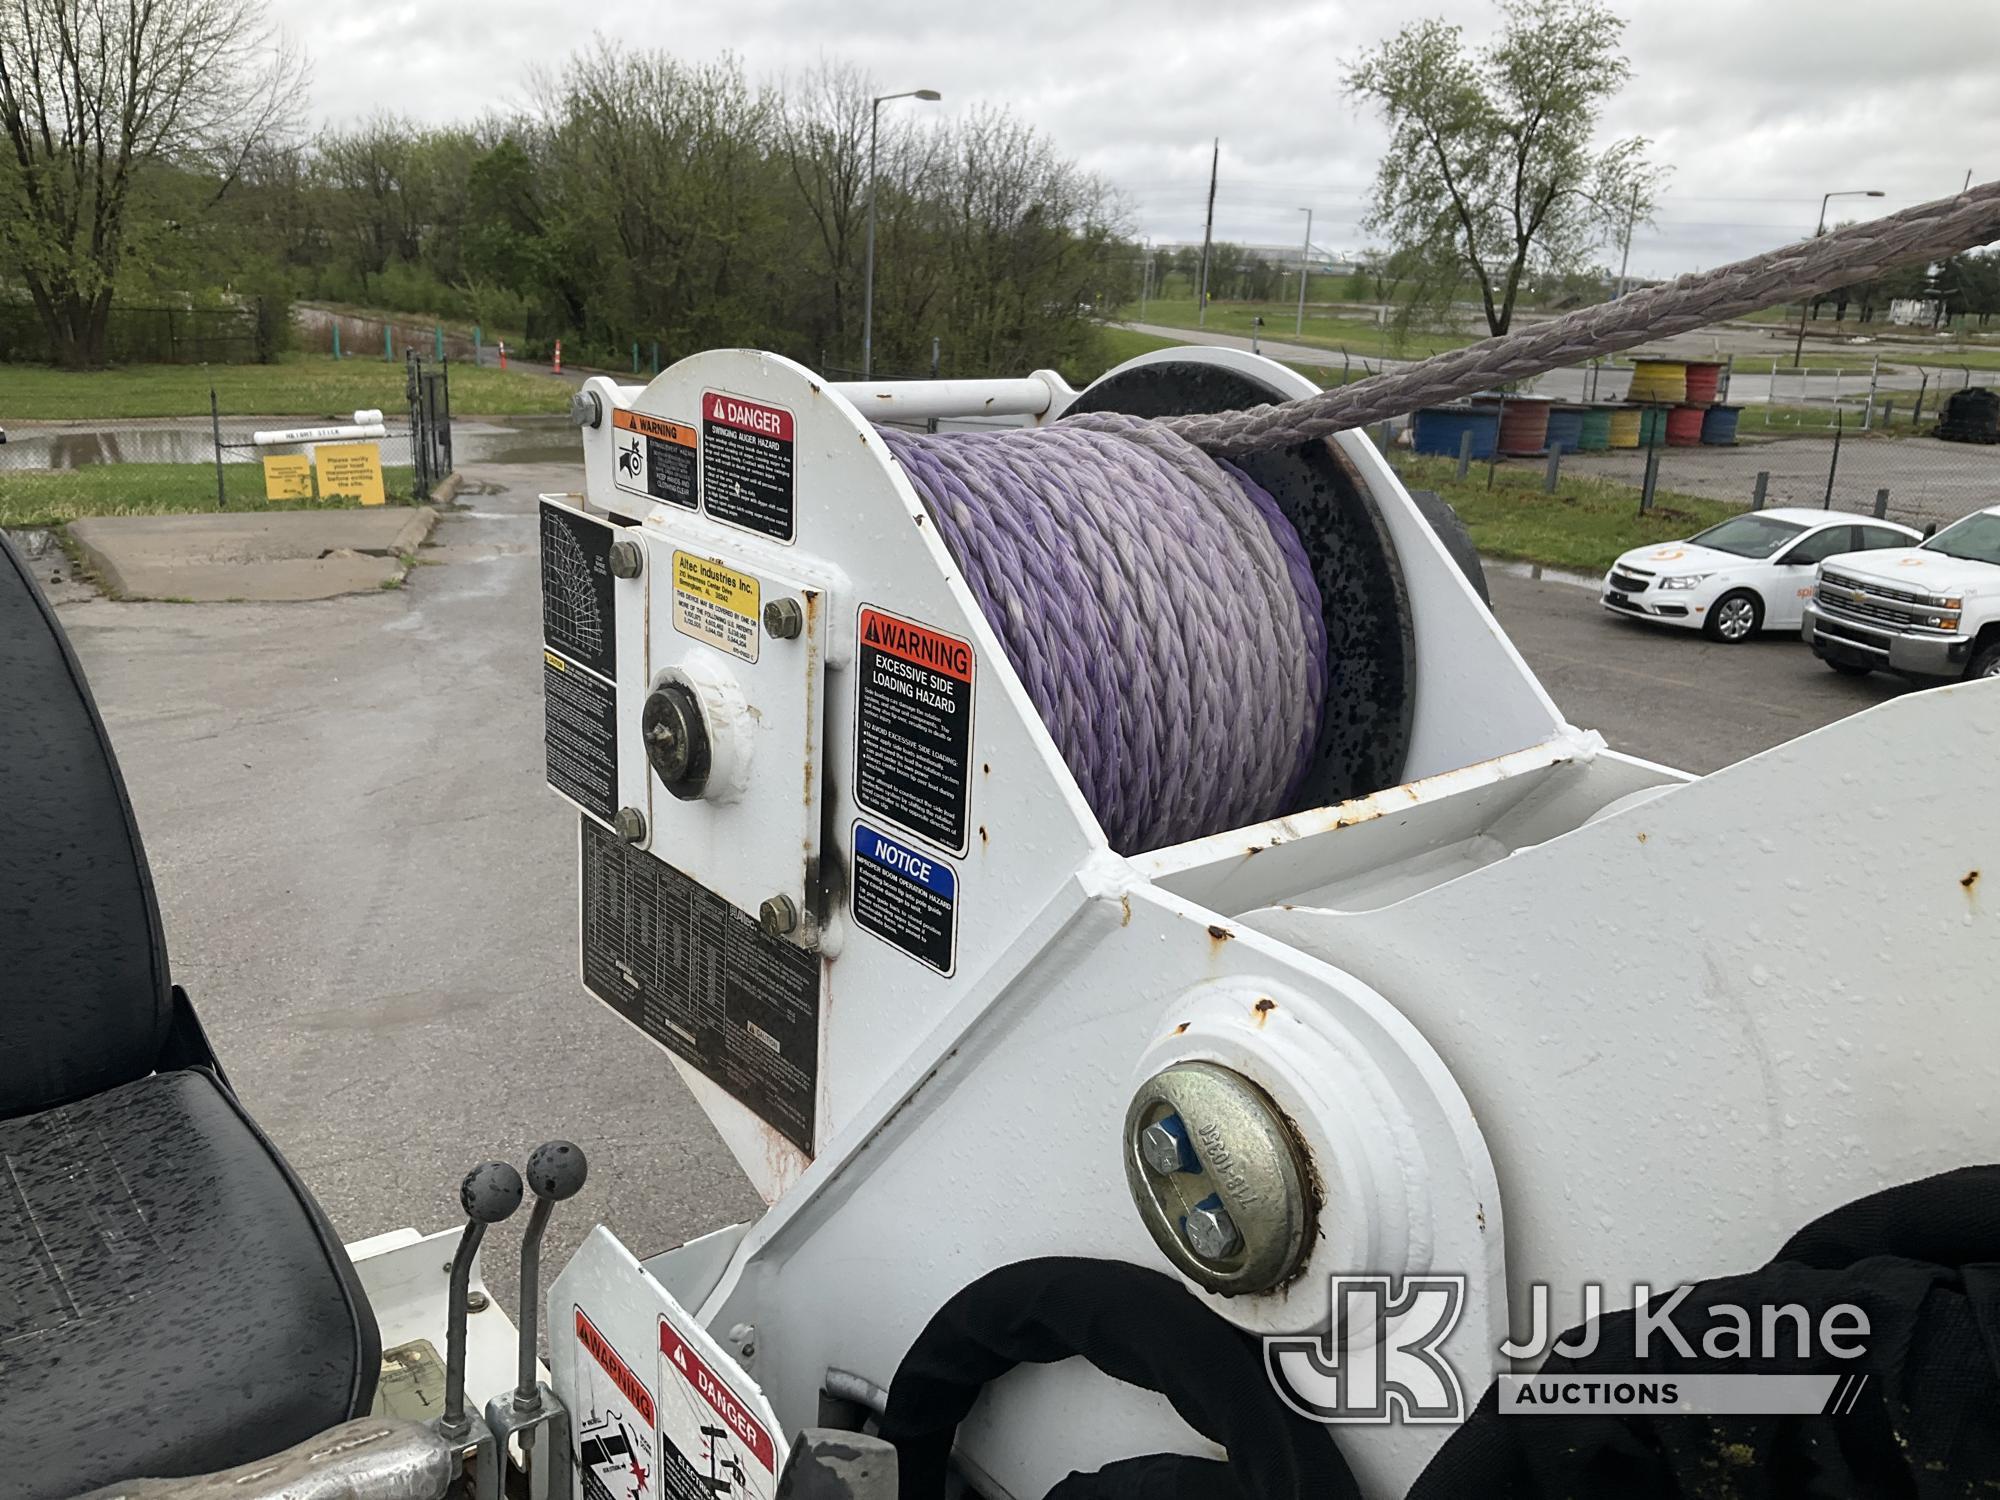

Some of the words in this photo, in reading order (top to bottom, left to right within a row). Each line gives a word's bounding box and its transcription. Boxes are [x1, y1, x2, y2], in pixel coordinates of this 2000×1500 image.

[640, 418, 677, 439] WARNING
[712, 425, 737, 439] SWINGING
[739, 433, 756, 445] AUGER
[758, 438, 779, 451] HAZARD
[728, 403, 781, 434] DANGER
[680, 557, 697, 573] Altec
[701, 565, 736, 588] Industries
[740, 579, 753, 594] Inc.
[1796, 586, 1814, 600] spi
[881, 621, 968, 676] WARNING
[873, 671, 913, 698] LOADING
[916, 687, 955, 715] HAZARD
[876, 654, 928, 686] EXCESSIVE
[930, 675, 954, 696] SIDE
[864, 720, 871, 729] TO
[872, 724, 887, 736] AVOID
[888, 731, 917, 749] EXCESSIVE
[918, 744, 930, 755] SIDE
[932, 750, 958, 767] LOADING:
[857, 855, 881, 873] IMPROPER
[882, 869, 897, 882] BOOM
[899, 878, 927, 898] OPERATION
[929, 894, 951, 911] HAZARD
[875, 838, 932, 885] NOTICE
[757, 1028, 778, 1048] CAUTION
[1198, 1122, 1258, 1210] 718-10350
[589, 1336, 651, 1419] WARNING
[698, 1369, 757, 1447] DANGER
[677, 1454, 714, 1499] ELECTRIC
